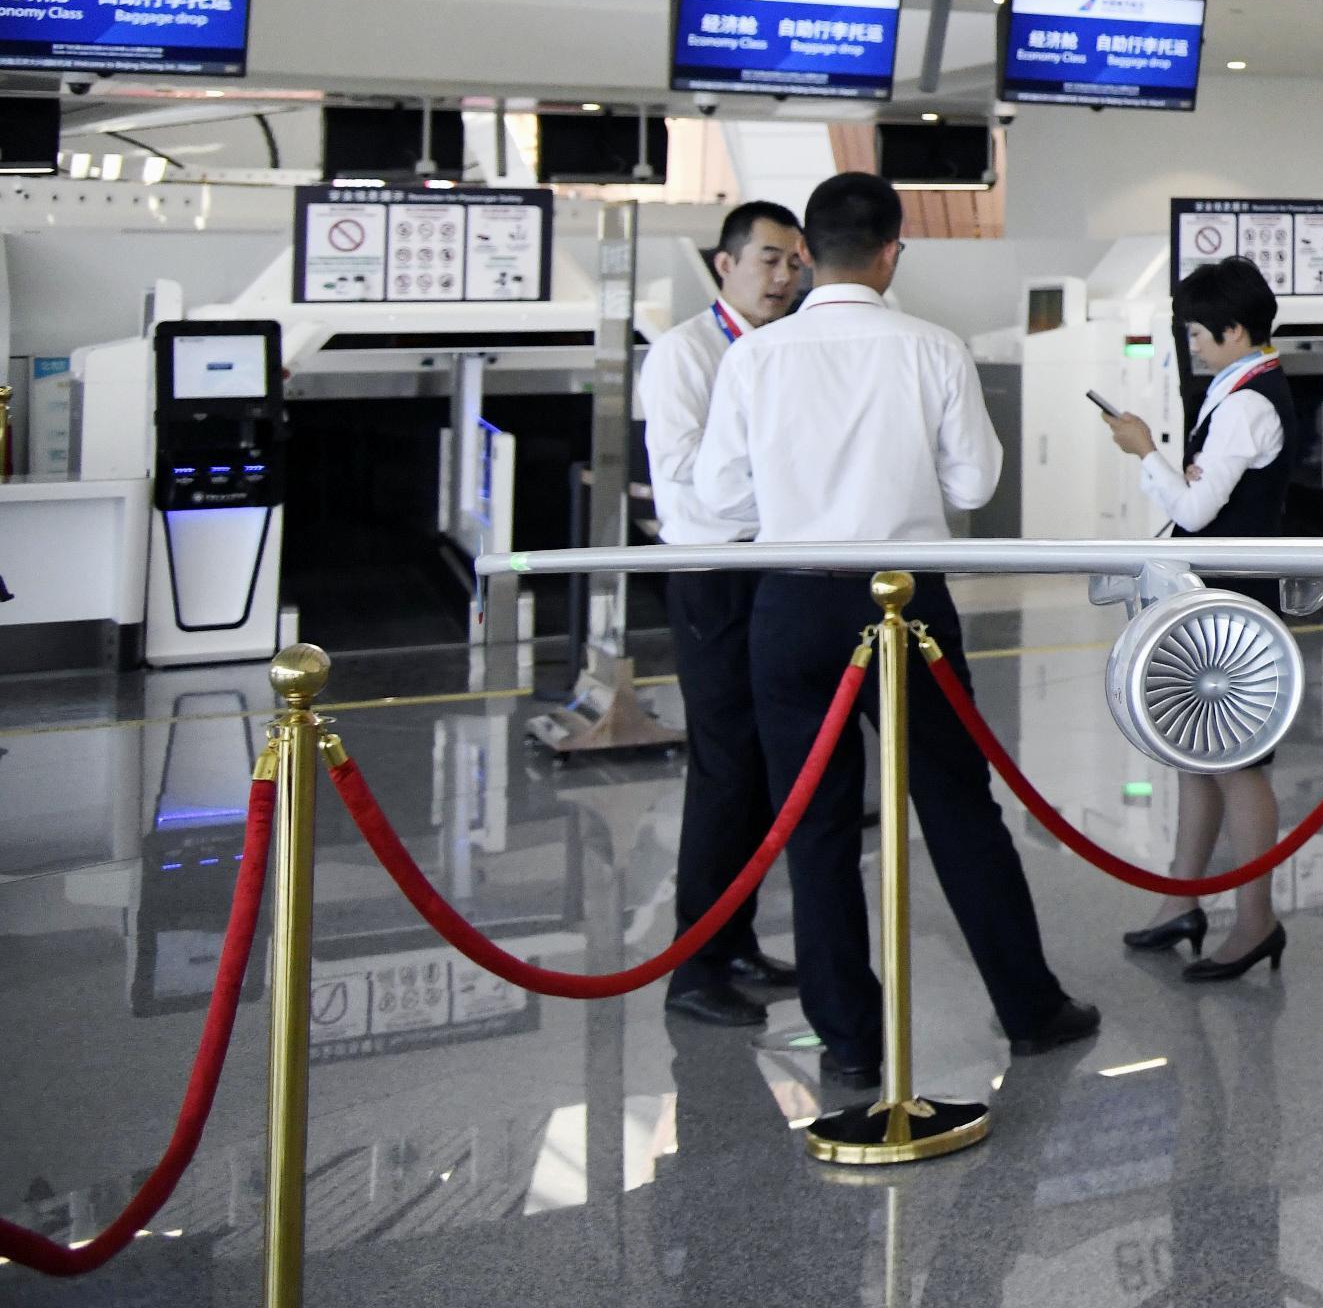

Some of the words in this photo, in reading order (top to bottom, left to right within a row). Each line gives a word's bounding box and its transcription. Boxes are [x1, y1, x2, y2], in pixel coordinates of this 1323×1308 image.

[48, 6, 84, 20] Class
[114, 9, 174, 26] Baggage
[175, 12, 209, 27] drop
[701, 13, 758, 35] 经济舱
[778, 18, 884, 43] 自助行李托运
[1028, 29, 1079, 50] 经济舱
[1096, 33, 1189, 57] 自助行李托运
